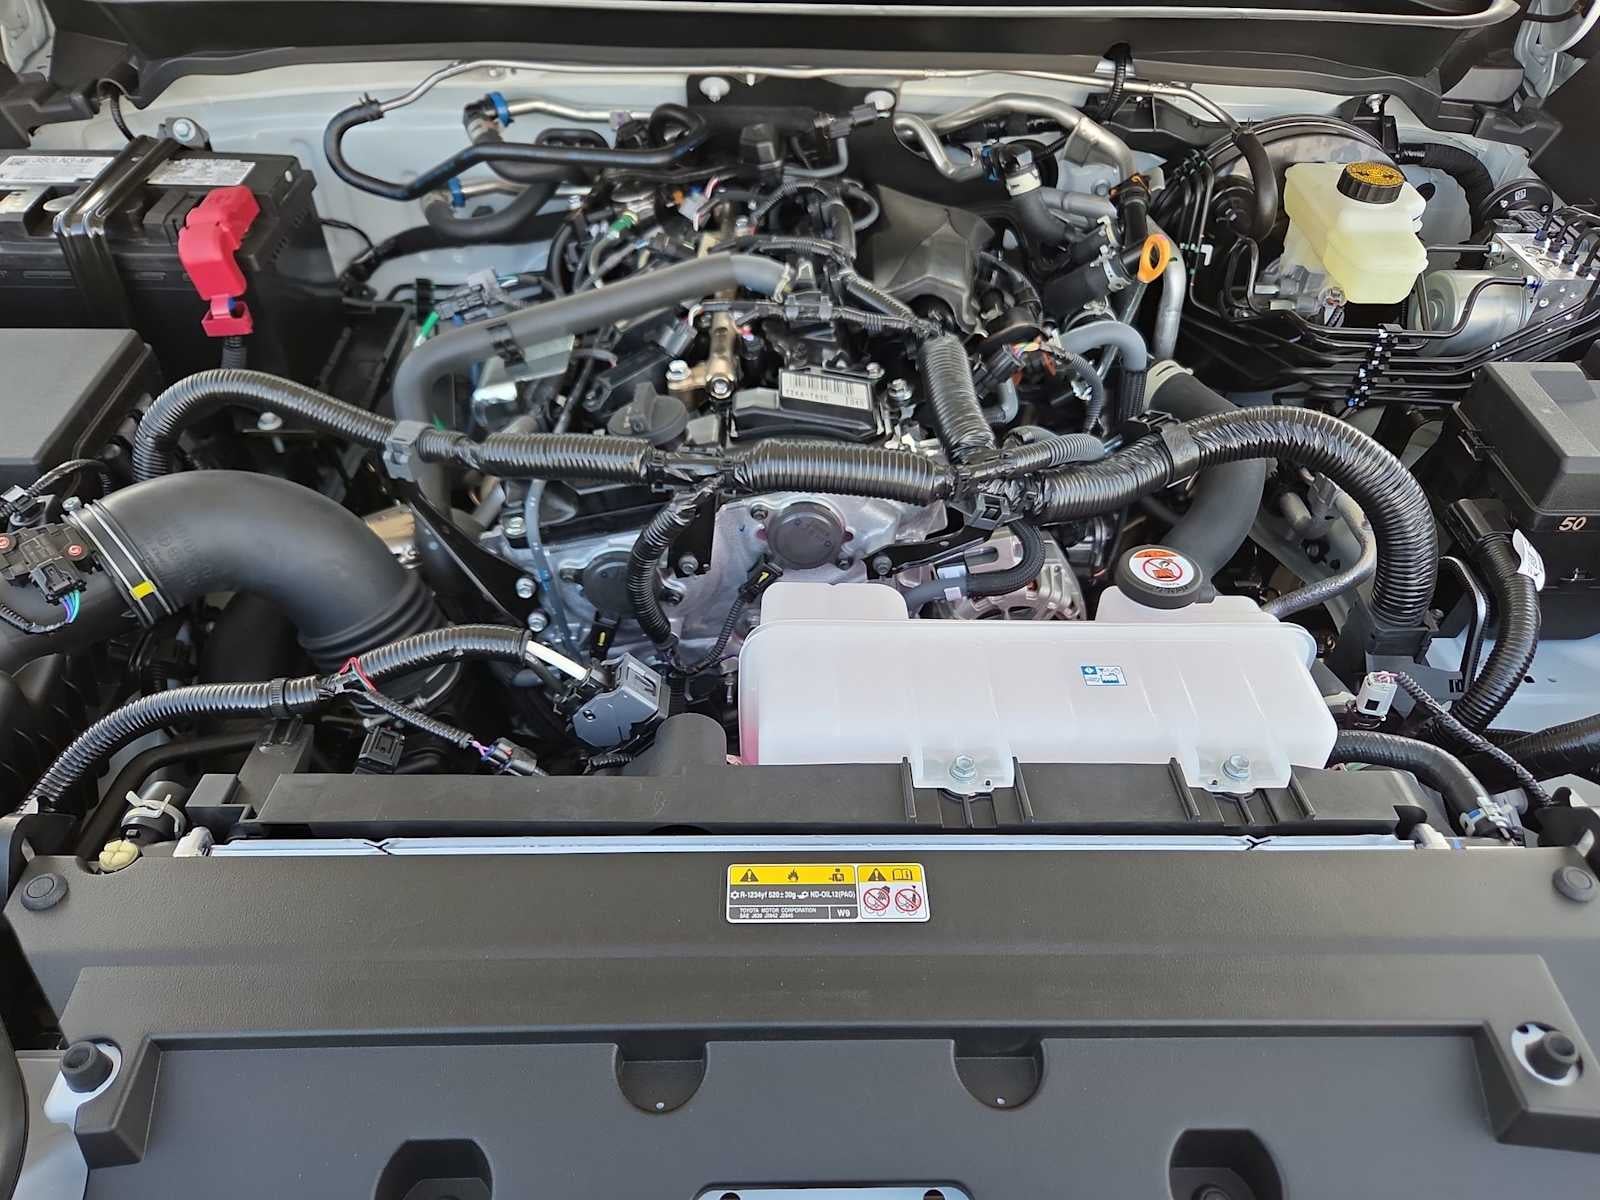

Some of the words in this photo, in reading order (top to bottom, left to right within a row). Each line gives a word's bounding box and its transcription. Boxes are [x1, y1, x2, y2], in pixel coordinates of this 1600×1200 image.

[1558, 516, 1587, 531] 50
[740, 890, 767, 900] R-1234yf
[837, 909, 851, 918] W9
